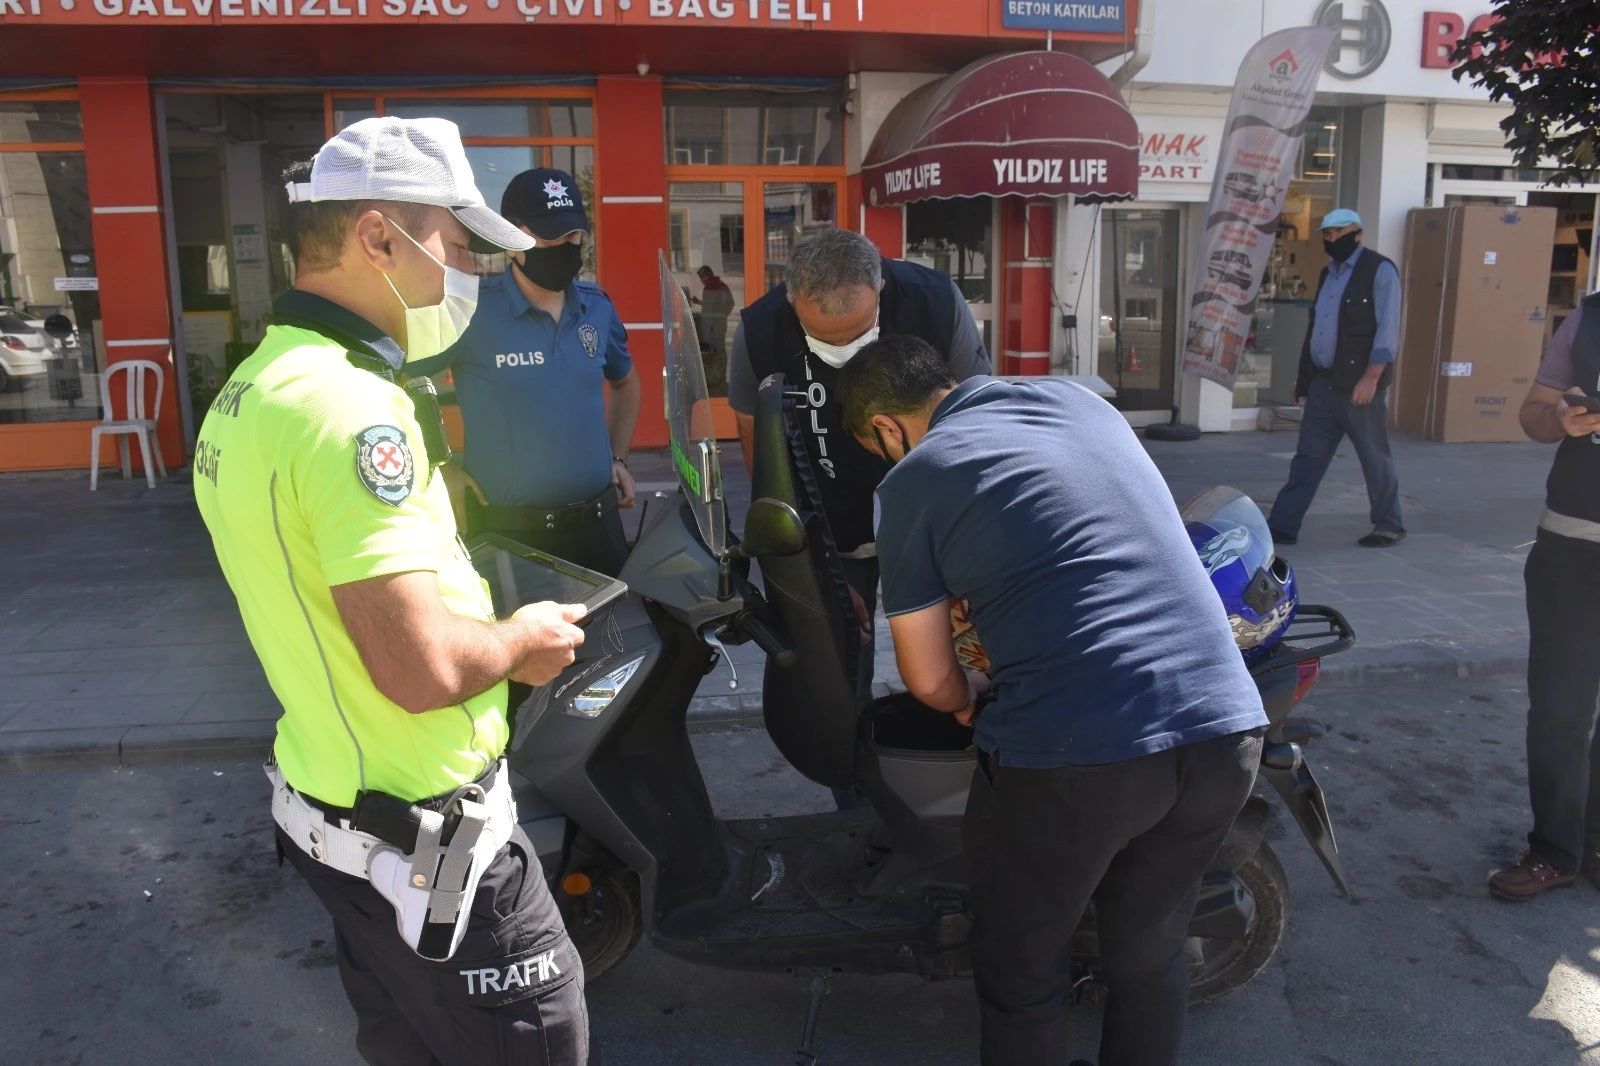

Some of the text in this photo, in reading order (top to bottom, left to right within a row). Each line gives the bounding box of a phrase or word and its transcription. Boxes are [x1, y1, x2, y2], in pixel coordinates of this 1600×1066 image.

[1008, 1, 1120, 20] BETON KATKILARI
[1138, 132, 1207, 157] NAK
[885, 162, 942, 196] YILDIZ LIFE
[993, 158, 1108, 186] YILDIZ LIFE
[547, 197, 574, 210] POLİS
[495, 351, 545, 368] POLİS
[1474, 396, 1508, 406] FRONT
